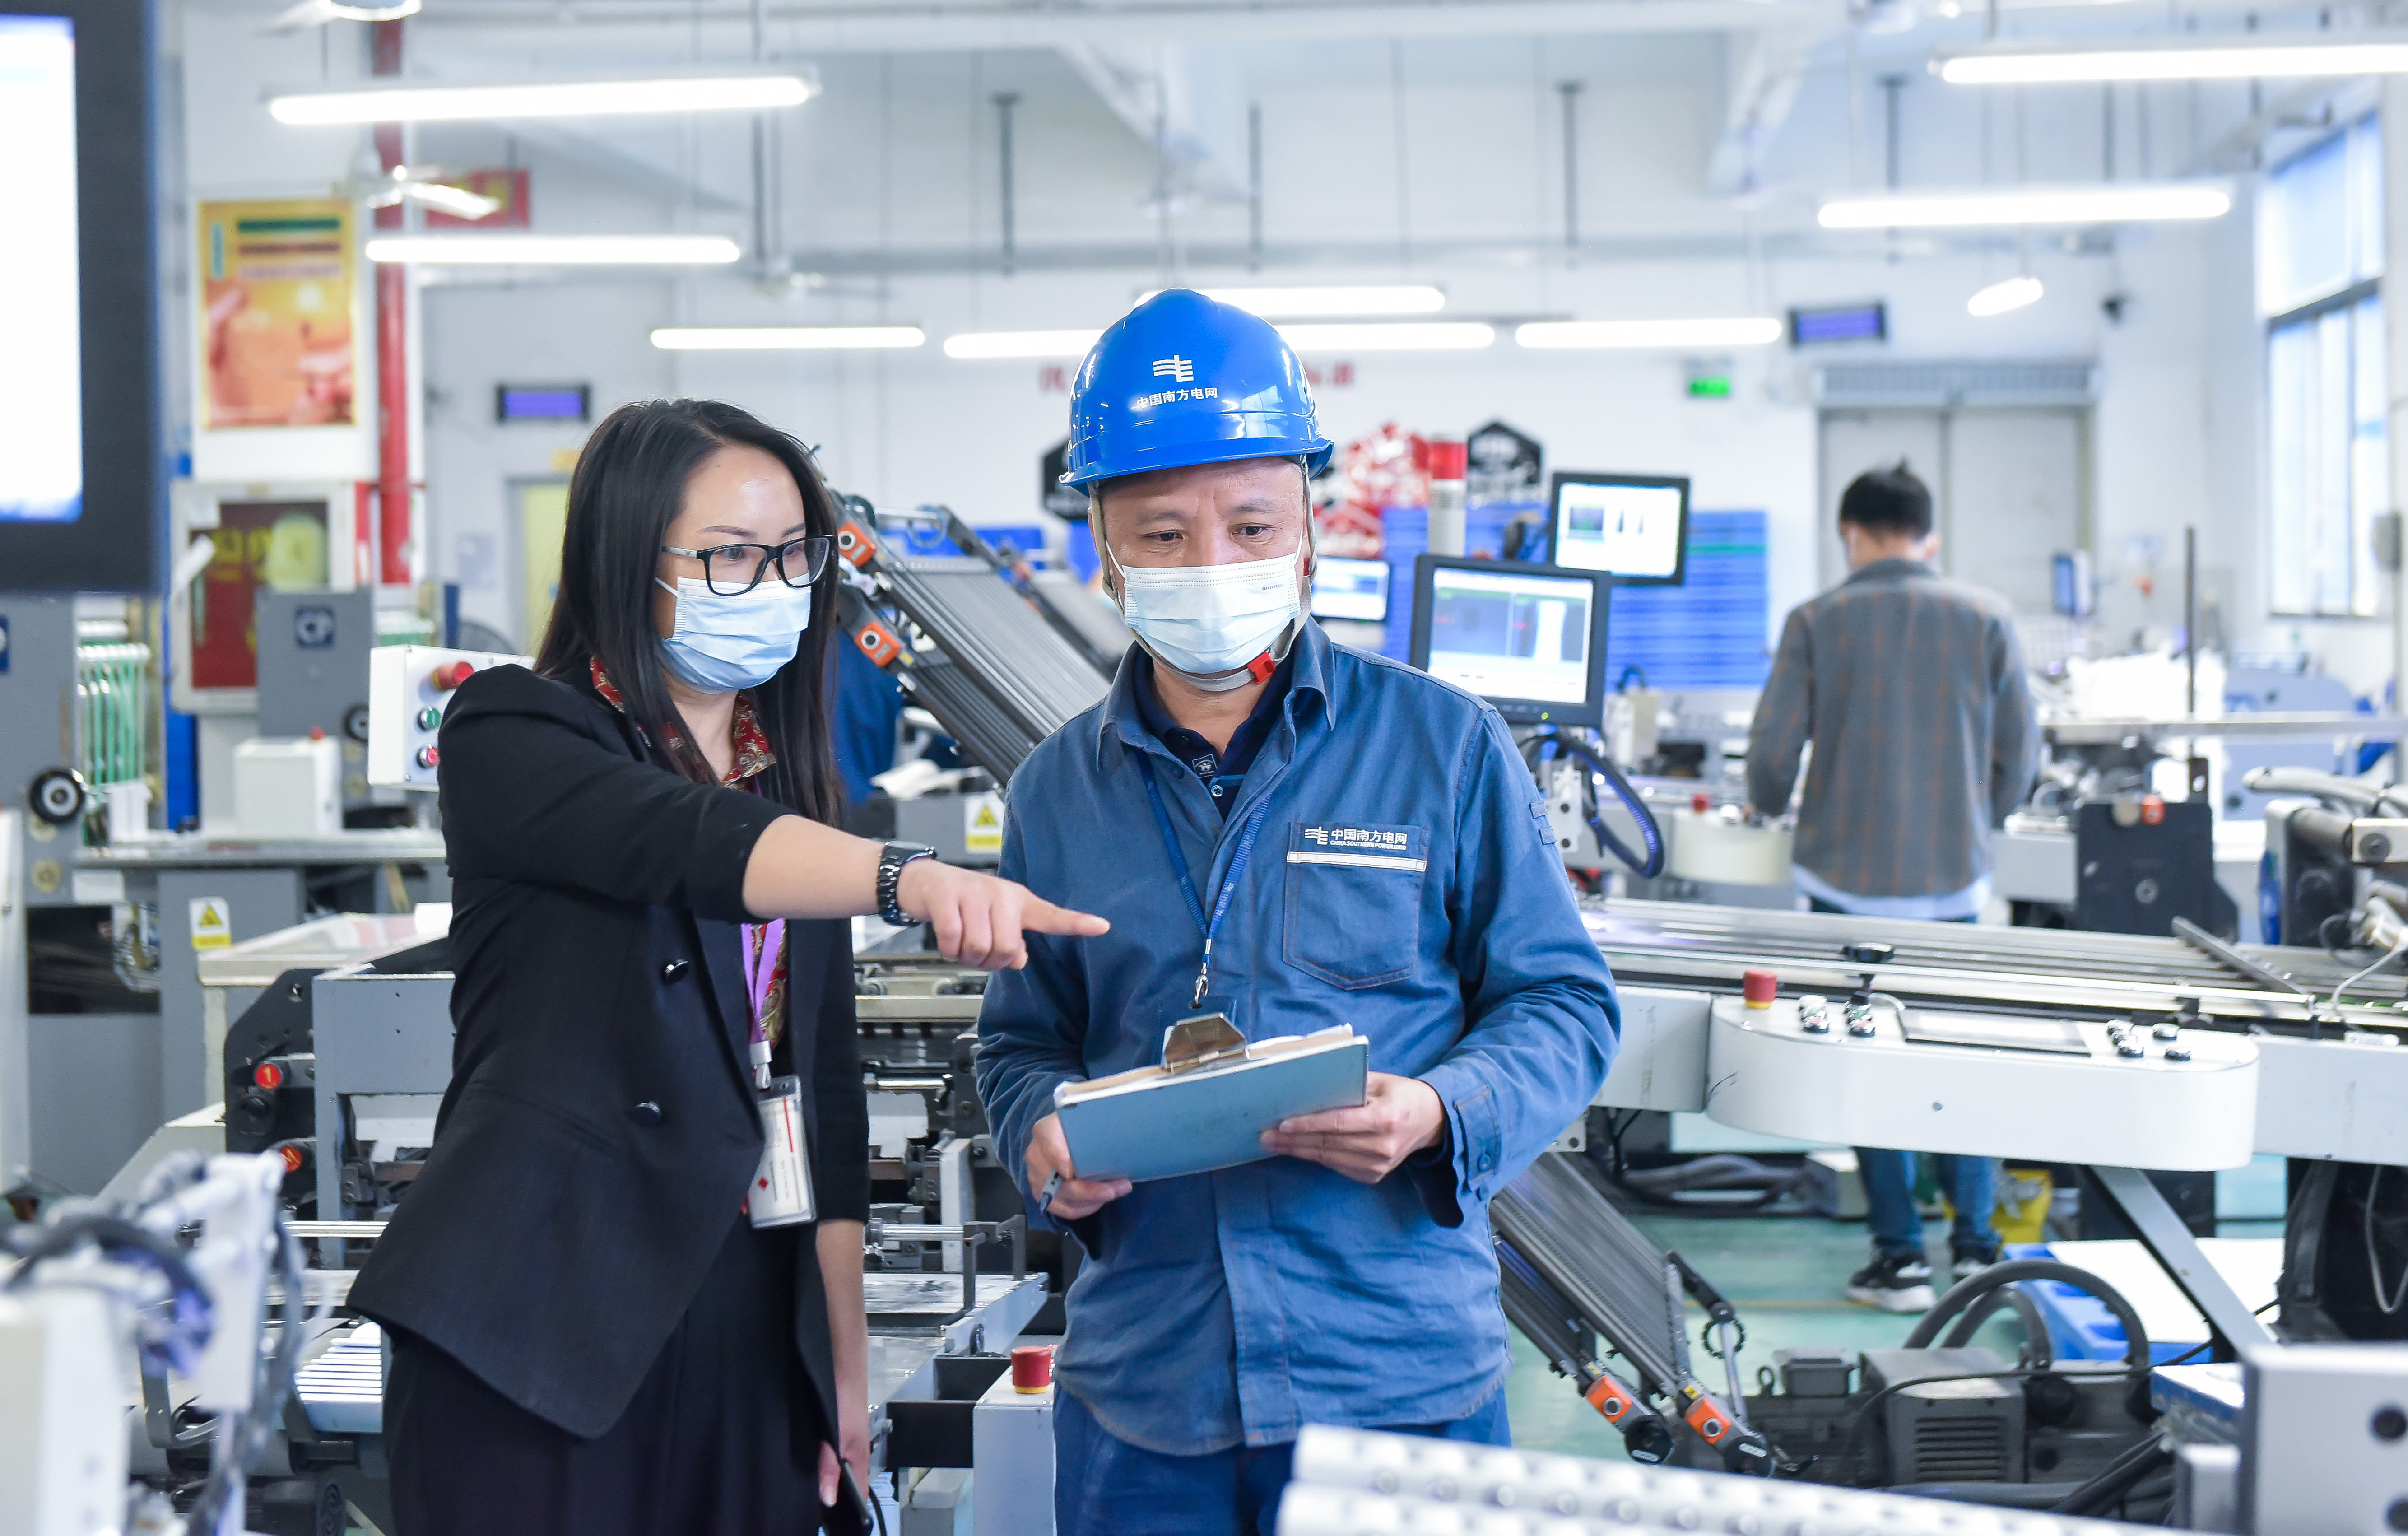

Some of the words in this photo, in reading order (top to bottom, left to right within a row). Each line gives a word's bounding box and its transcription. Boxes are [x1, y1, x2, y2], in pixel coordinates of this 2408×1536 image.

[1136, 387, 1218, 409] 中国南方电网
[1331, 828, 1407, 844] 中国南方电网
